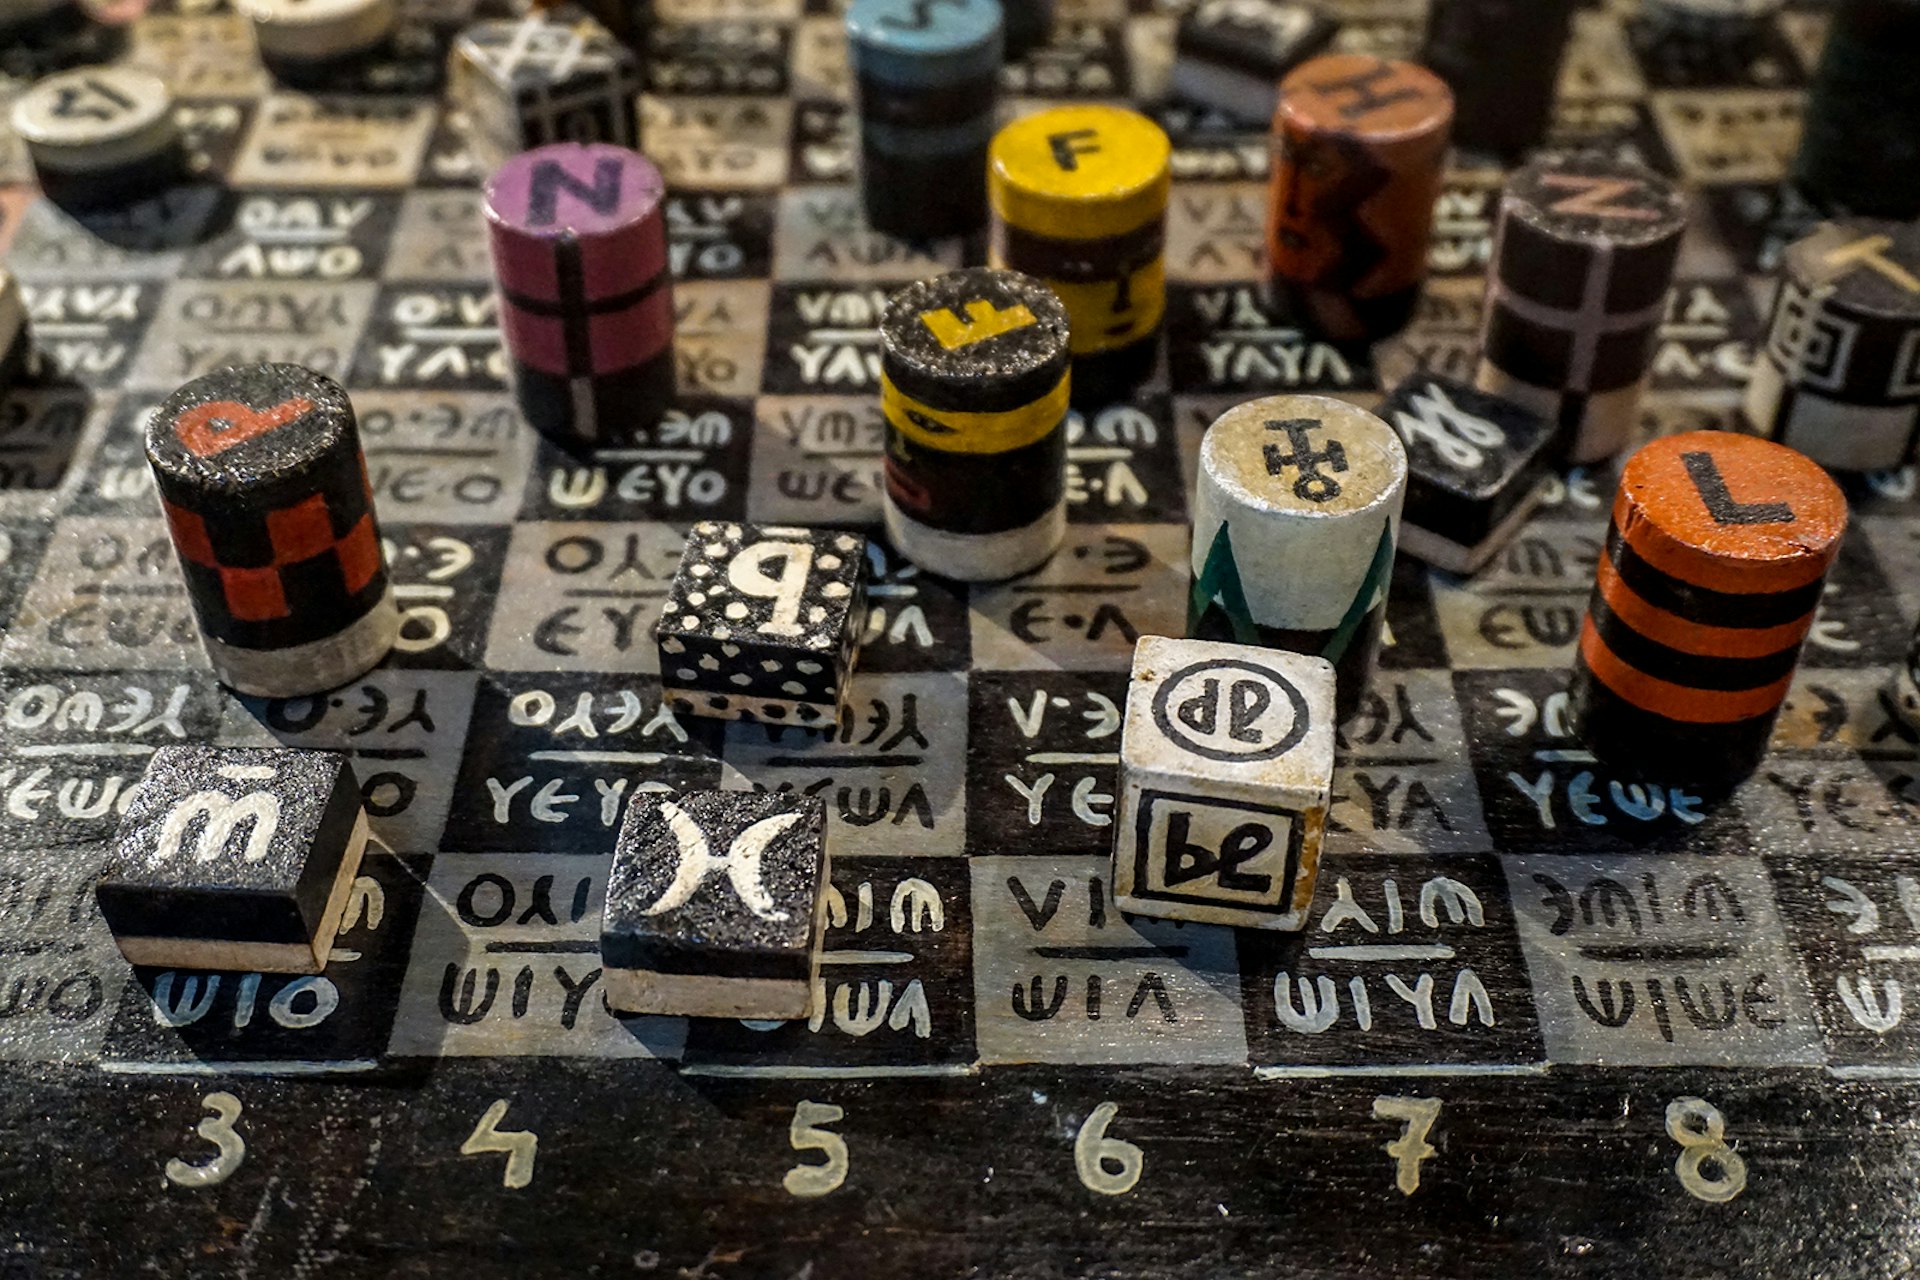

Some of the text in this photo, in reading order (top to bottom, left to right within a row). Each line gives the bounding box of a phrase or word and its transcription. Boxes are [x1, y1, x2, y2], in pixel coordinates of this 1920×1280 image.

[523, 157, 625, 227] N
[1046, 128, 1102, 172] F
[919, 300, 1038, 352] F
[1679, 450, 1797, 526] L
[164, 1091, 246, 1188] 3
[460, 1099, 539, 1189] 4
[782, 1099, 850, 1196] 5
[1074, 1101, 1145, 1196] 6
[1372, 1096, 1443, 1195] 7
[1664, 1096, 1748, 1202] 8
